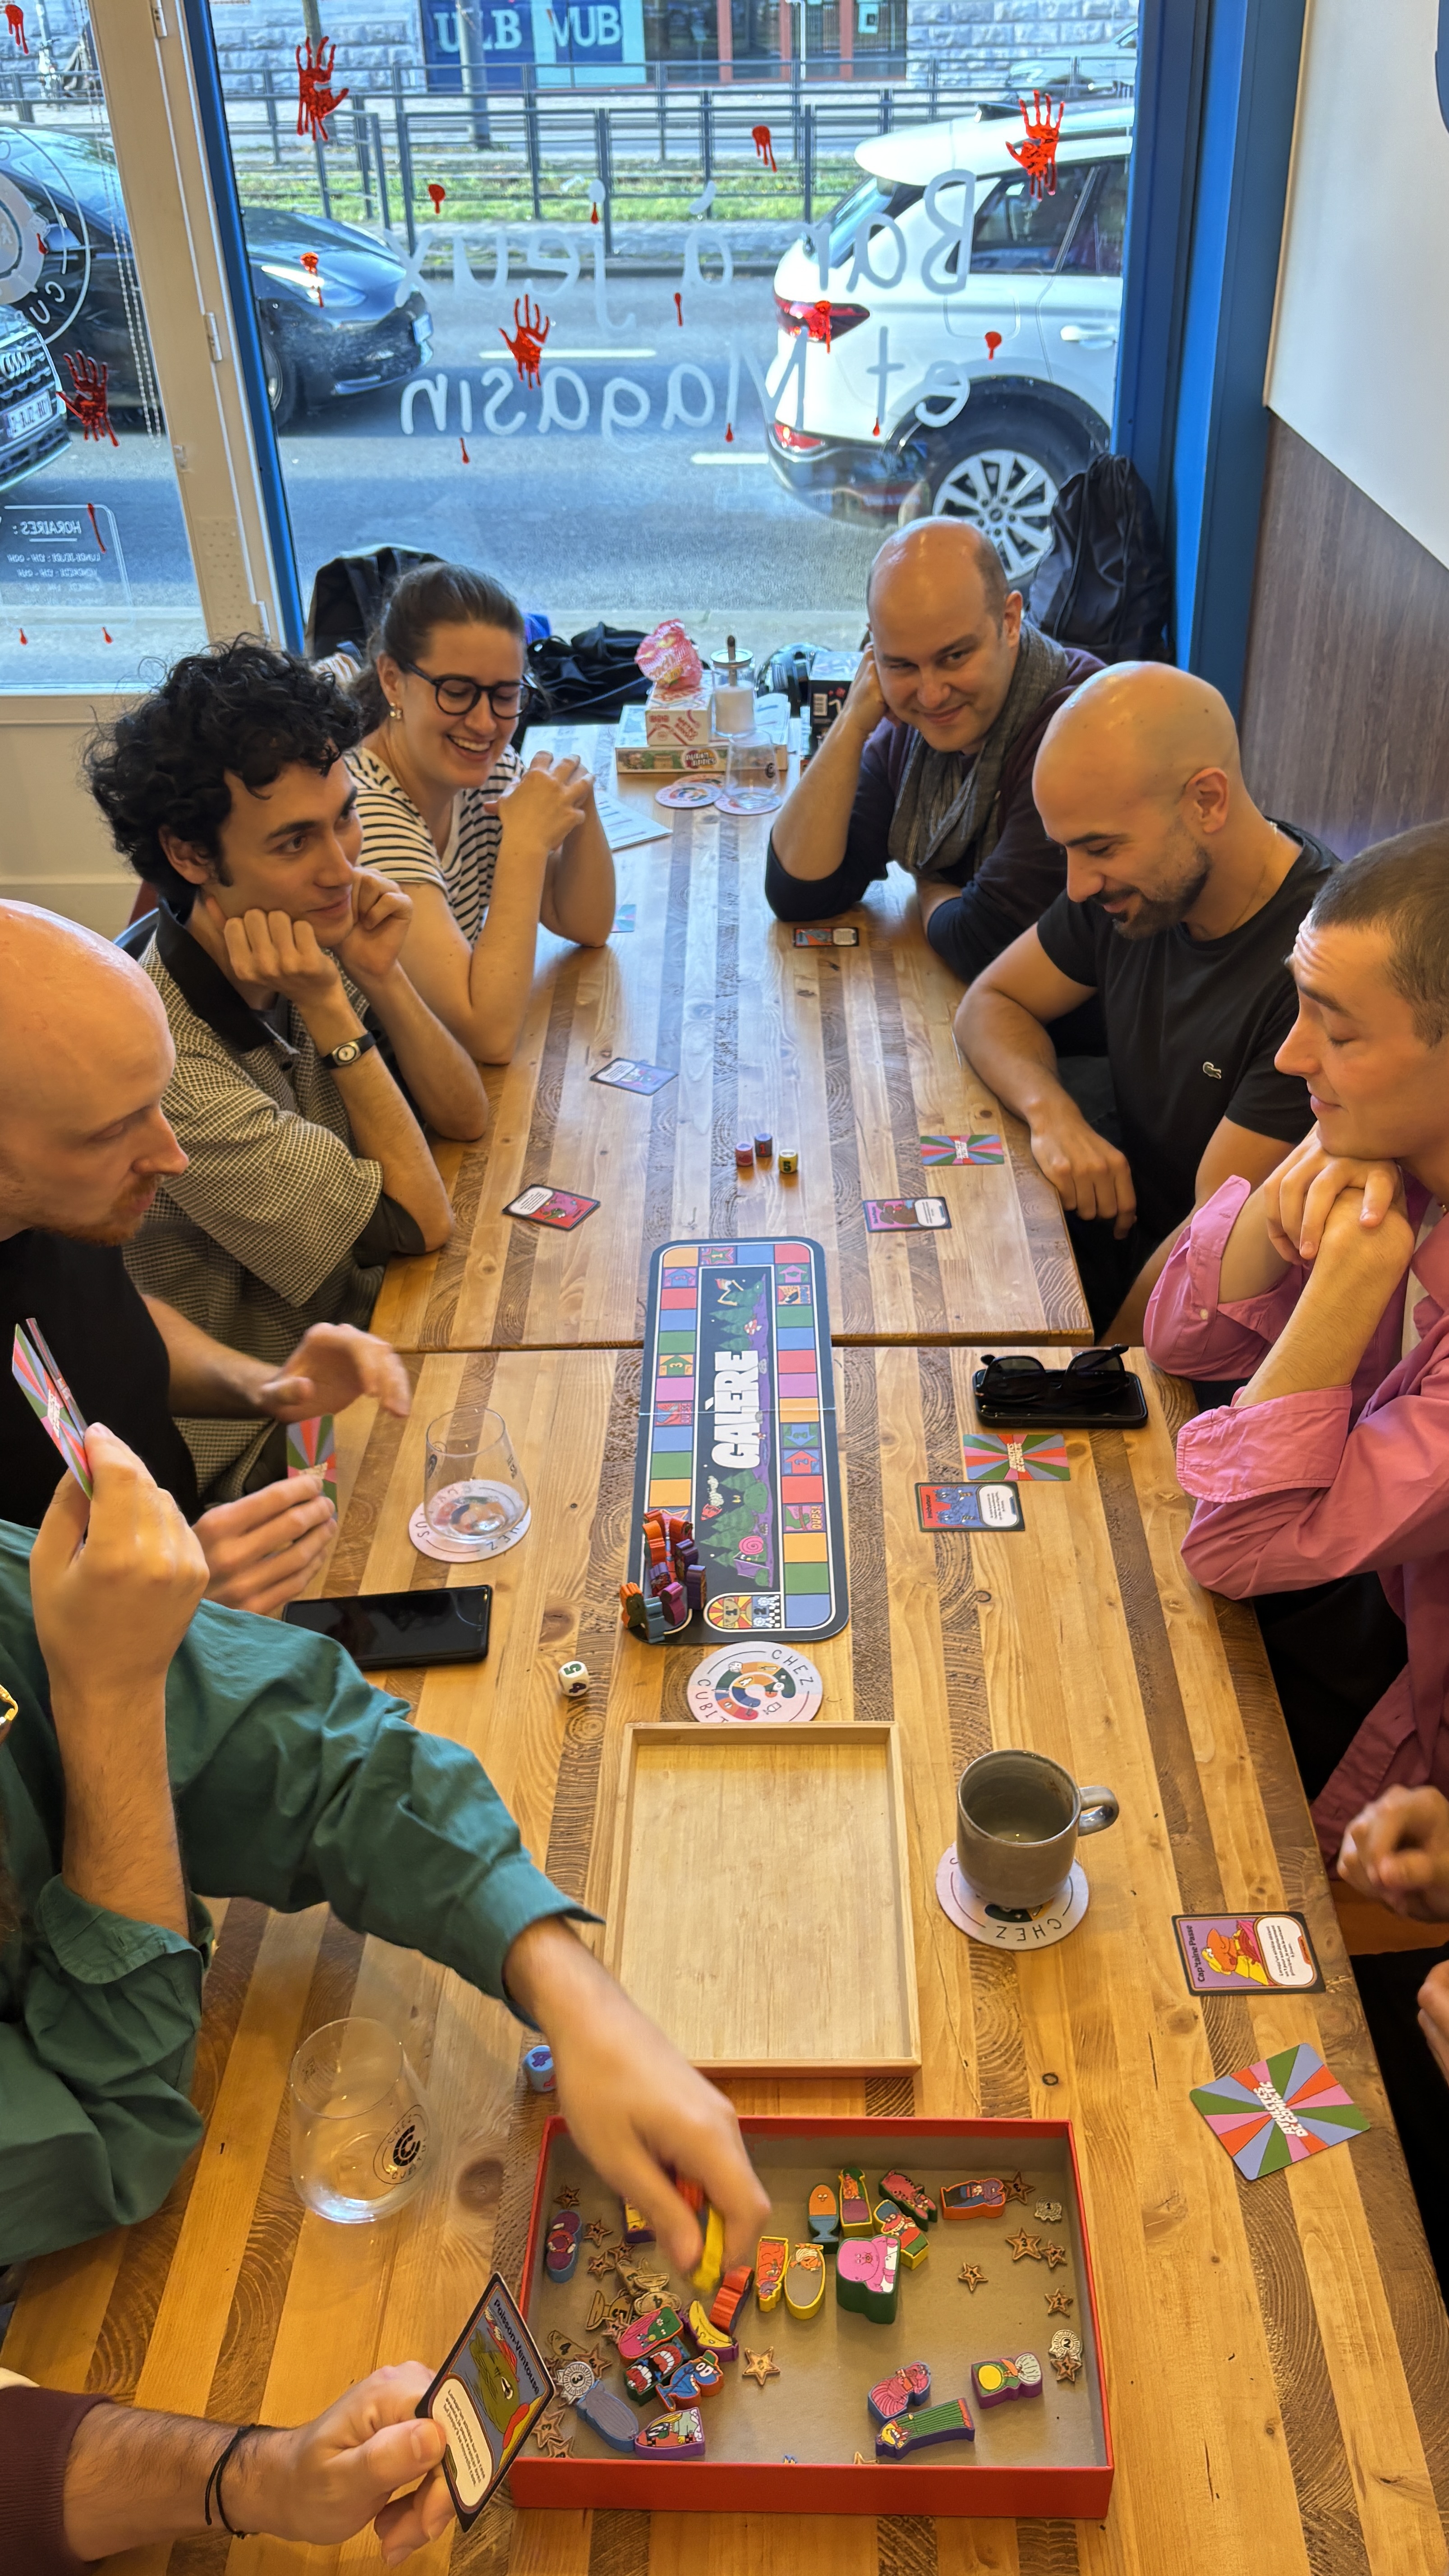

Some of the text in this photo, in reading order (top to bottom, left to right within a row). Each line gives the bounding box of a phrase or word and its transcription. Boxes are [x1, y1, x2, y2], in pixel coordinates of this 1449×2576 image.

[546, 5, 621, 47] VUB
[759, 1143, 765, 1155] 1
[783, 1161, 791, 1172] 5
[705, 1350, 760, 1469] GALÈRE
[811, 1505, 823, 1530] OUPS!
[563, 1663, 582, 1675] 5
[771, 1649, 814, 1686] CHEZ
[995, 1918, 1062, 1941] CHEZ
[1186, 1924, 1197, 1946] Passe
[1021, 2237, 1028, 2247] 3
[1063, 2338, 1071, 2349] 2
